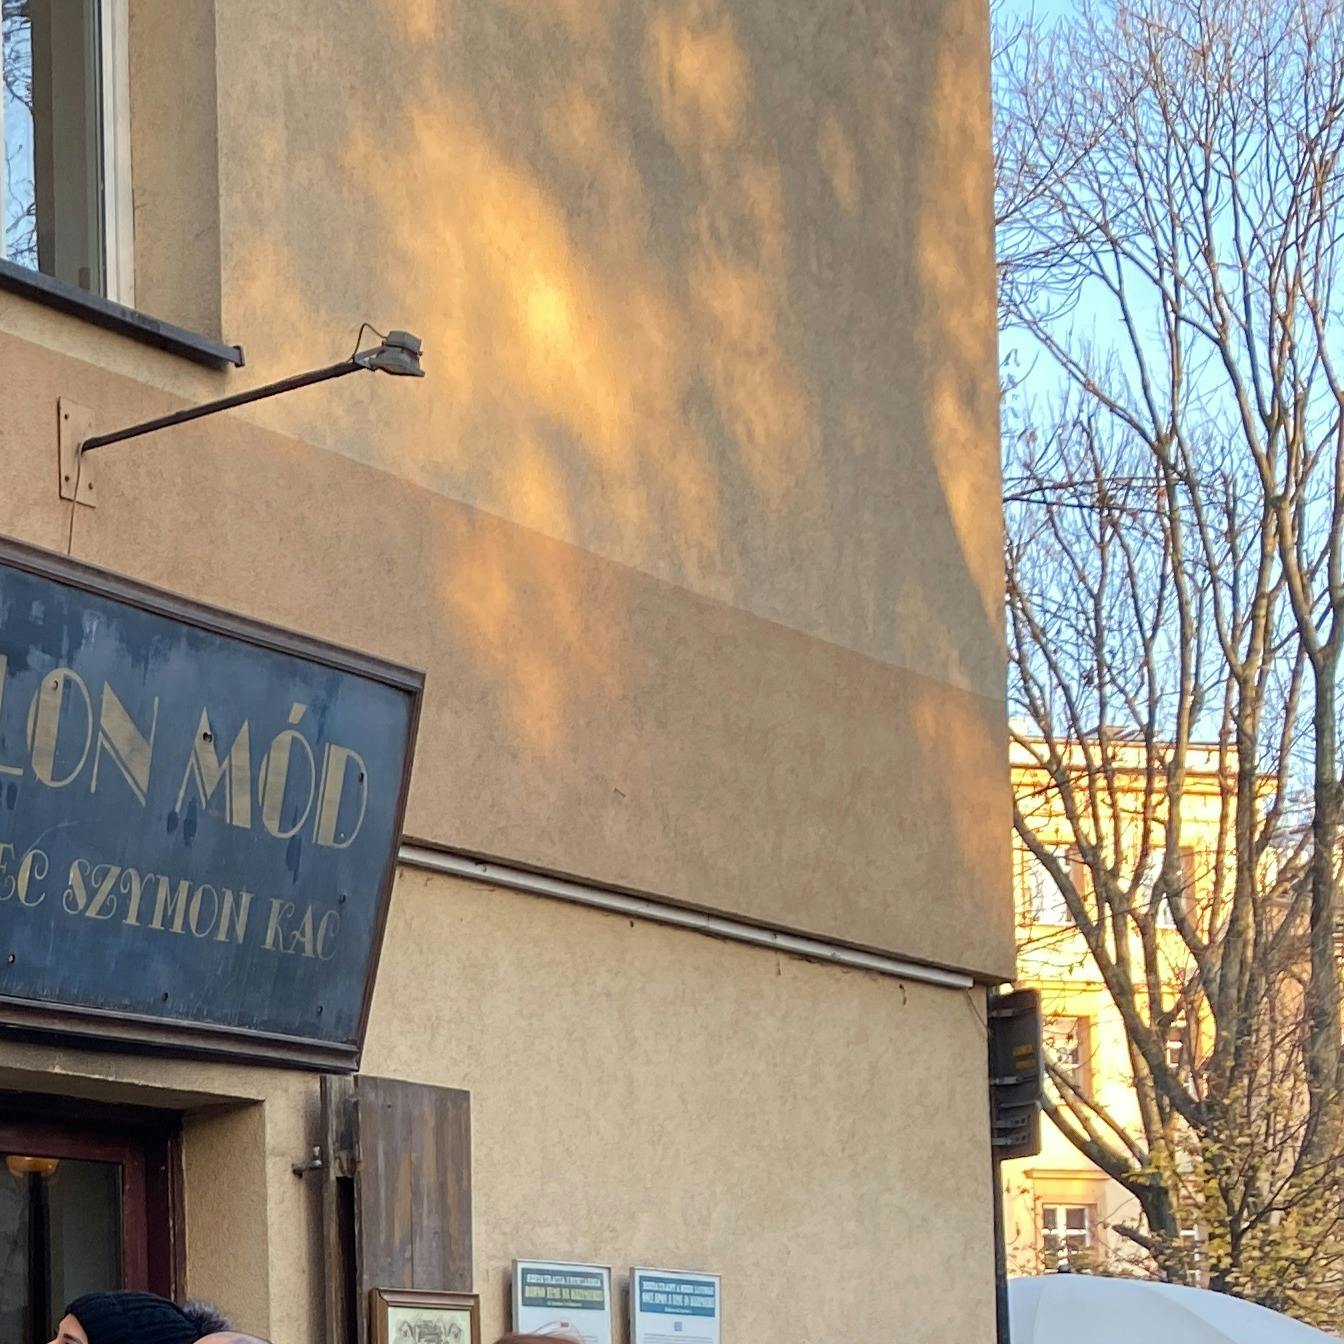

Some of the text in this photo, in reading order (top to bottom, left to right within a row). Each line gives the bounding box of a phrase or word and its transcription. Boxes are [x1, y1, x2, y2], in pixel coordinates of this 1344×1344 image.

[175, 703, 369, 849] MÓD
[62, 857, 255, 944] SZYMON
[263, 896, 341, 961] KAC
